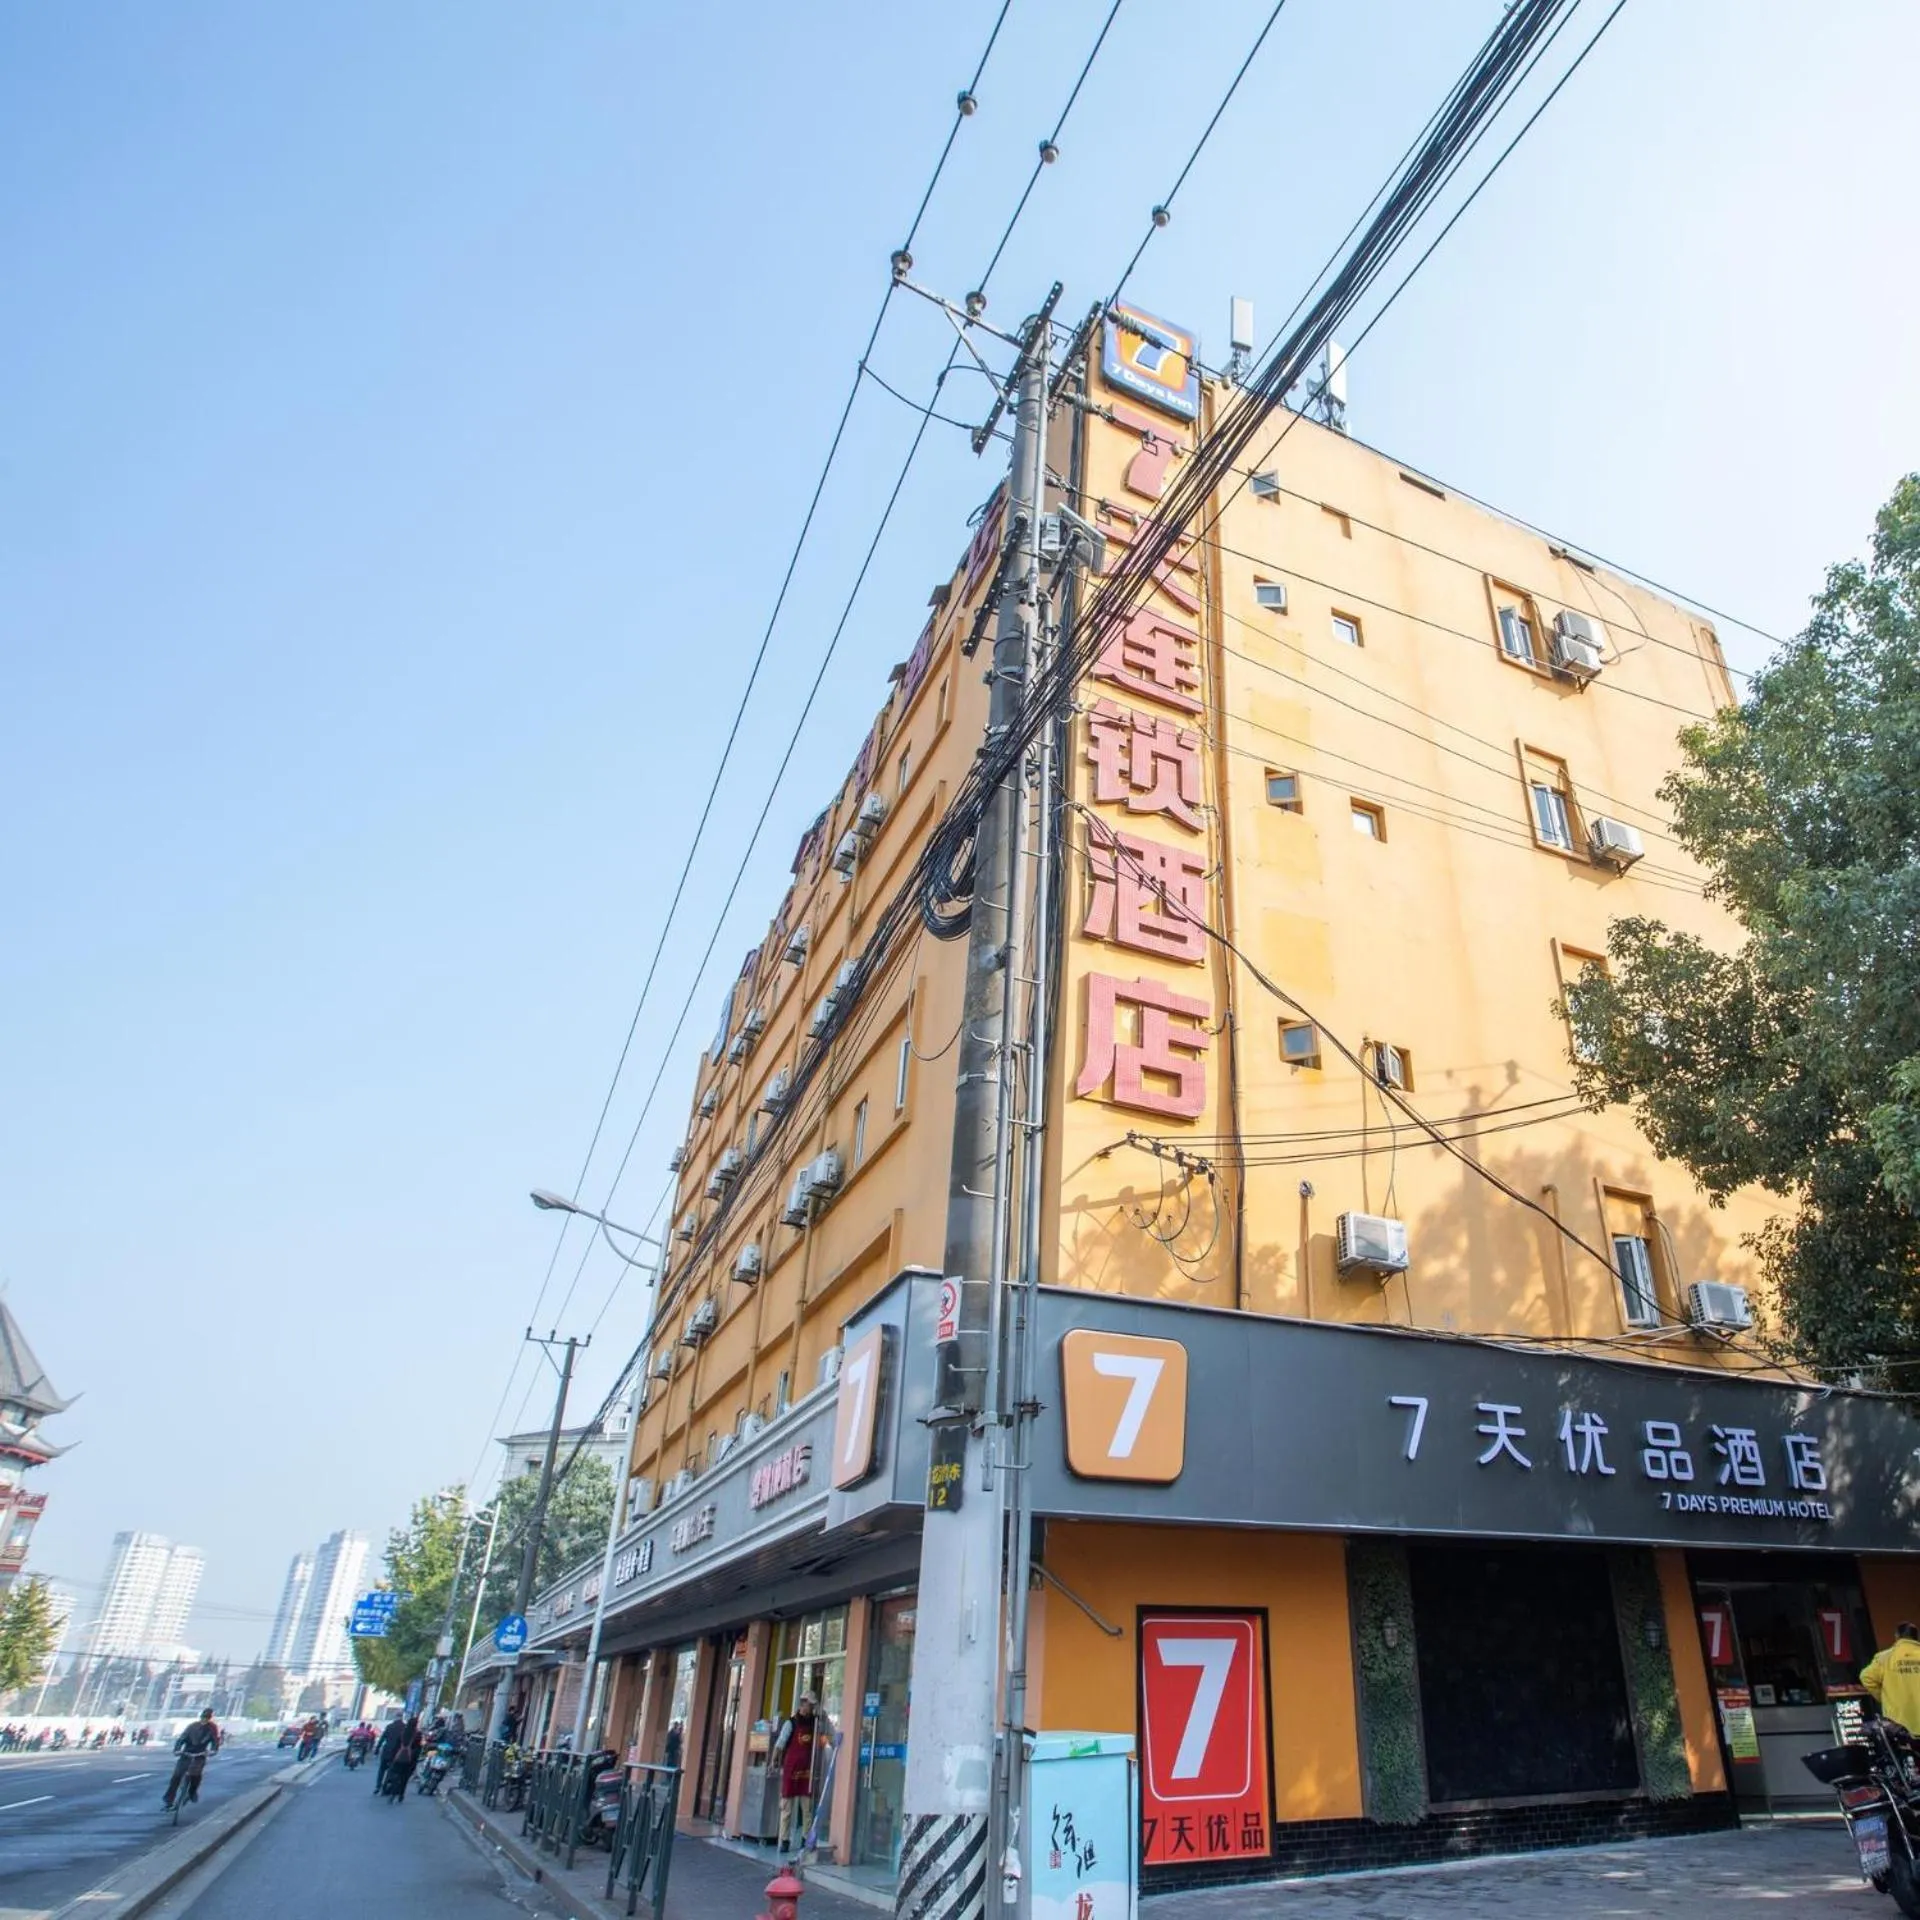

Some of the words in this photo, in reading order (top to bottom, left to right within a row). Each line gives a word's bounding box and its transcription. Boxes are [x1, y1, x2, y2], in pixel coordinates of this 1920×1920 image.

[1111, 362, 1122, 374] 7
[844, 1349, 872, 1464] 7
[1093, 1352, 1166, 1459] 7
[1388, 1394, 1829, 1492] 7天优品酒店
[1661, 1491, 1672, 1510] 7
[1677, 1493, 1718, 1513] DAYS
[1720, 1496, 1786, 1517] PREMIUM
[1788, 1501, 1835, 1520] HOTEL
[1702, 1612, 1722, 1658] 7
[1822, 1612, 1841, 1656] 7
[1157, 1638, 1238, 1780] 7
[1143, 1811, 1266, 1858] 7天优品
